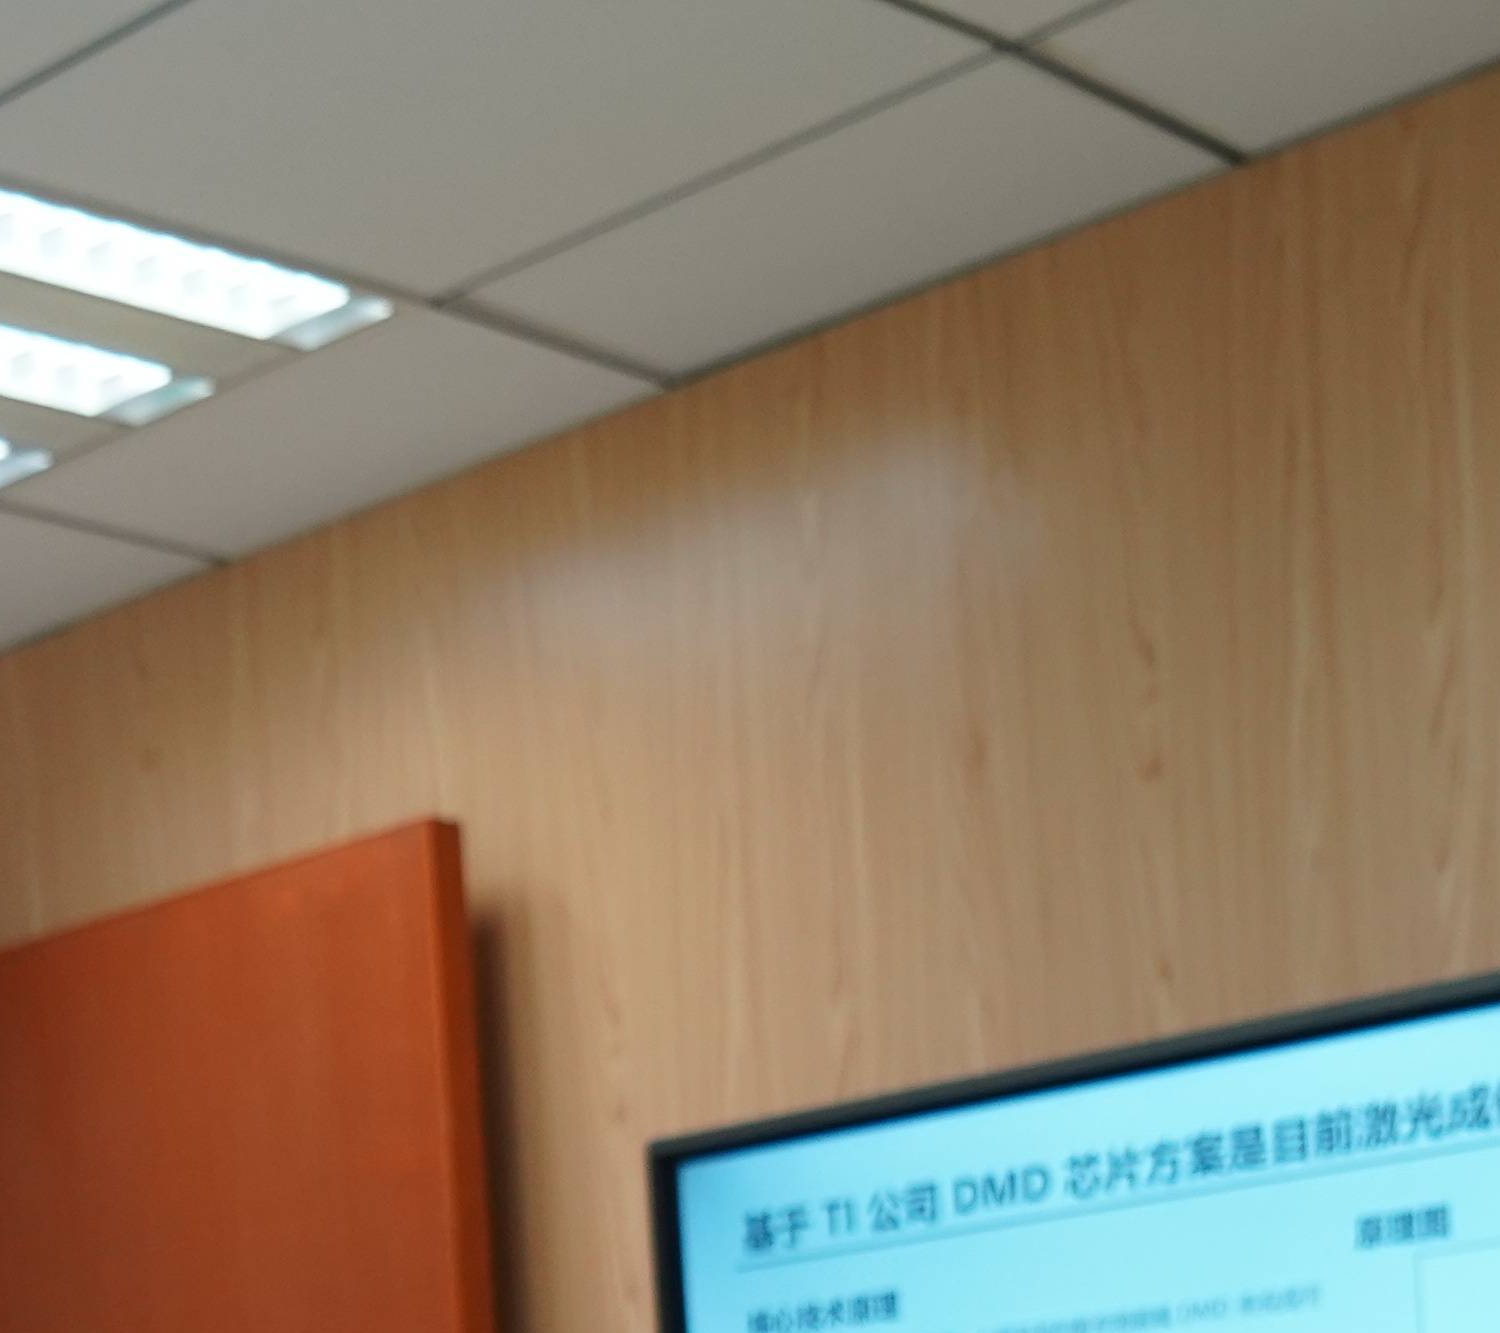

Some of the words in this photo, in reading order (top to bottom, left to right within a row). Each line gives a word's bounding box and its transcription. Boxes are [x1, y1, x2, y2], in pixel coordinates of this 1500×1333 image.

[741, 1207, 809, 1253] 基于
[869, 1182, 936, 1233] 公司
[953, 1165, 1051, 1216] DMD
